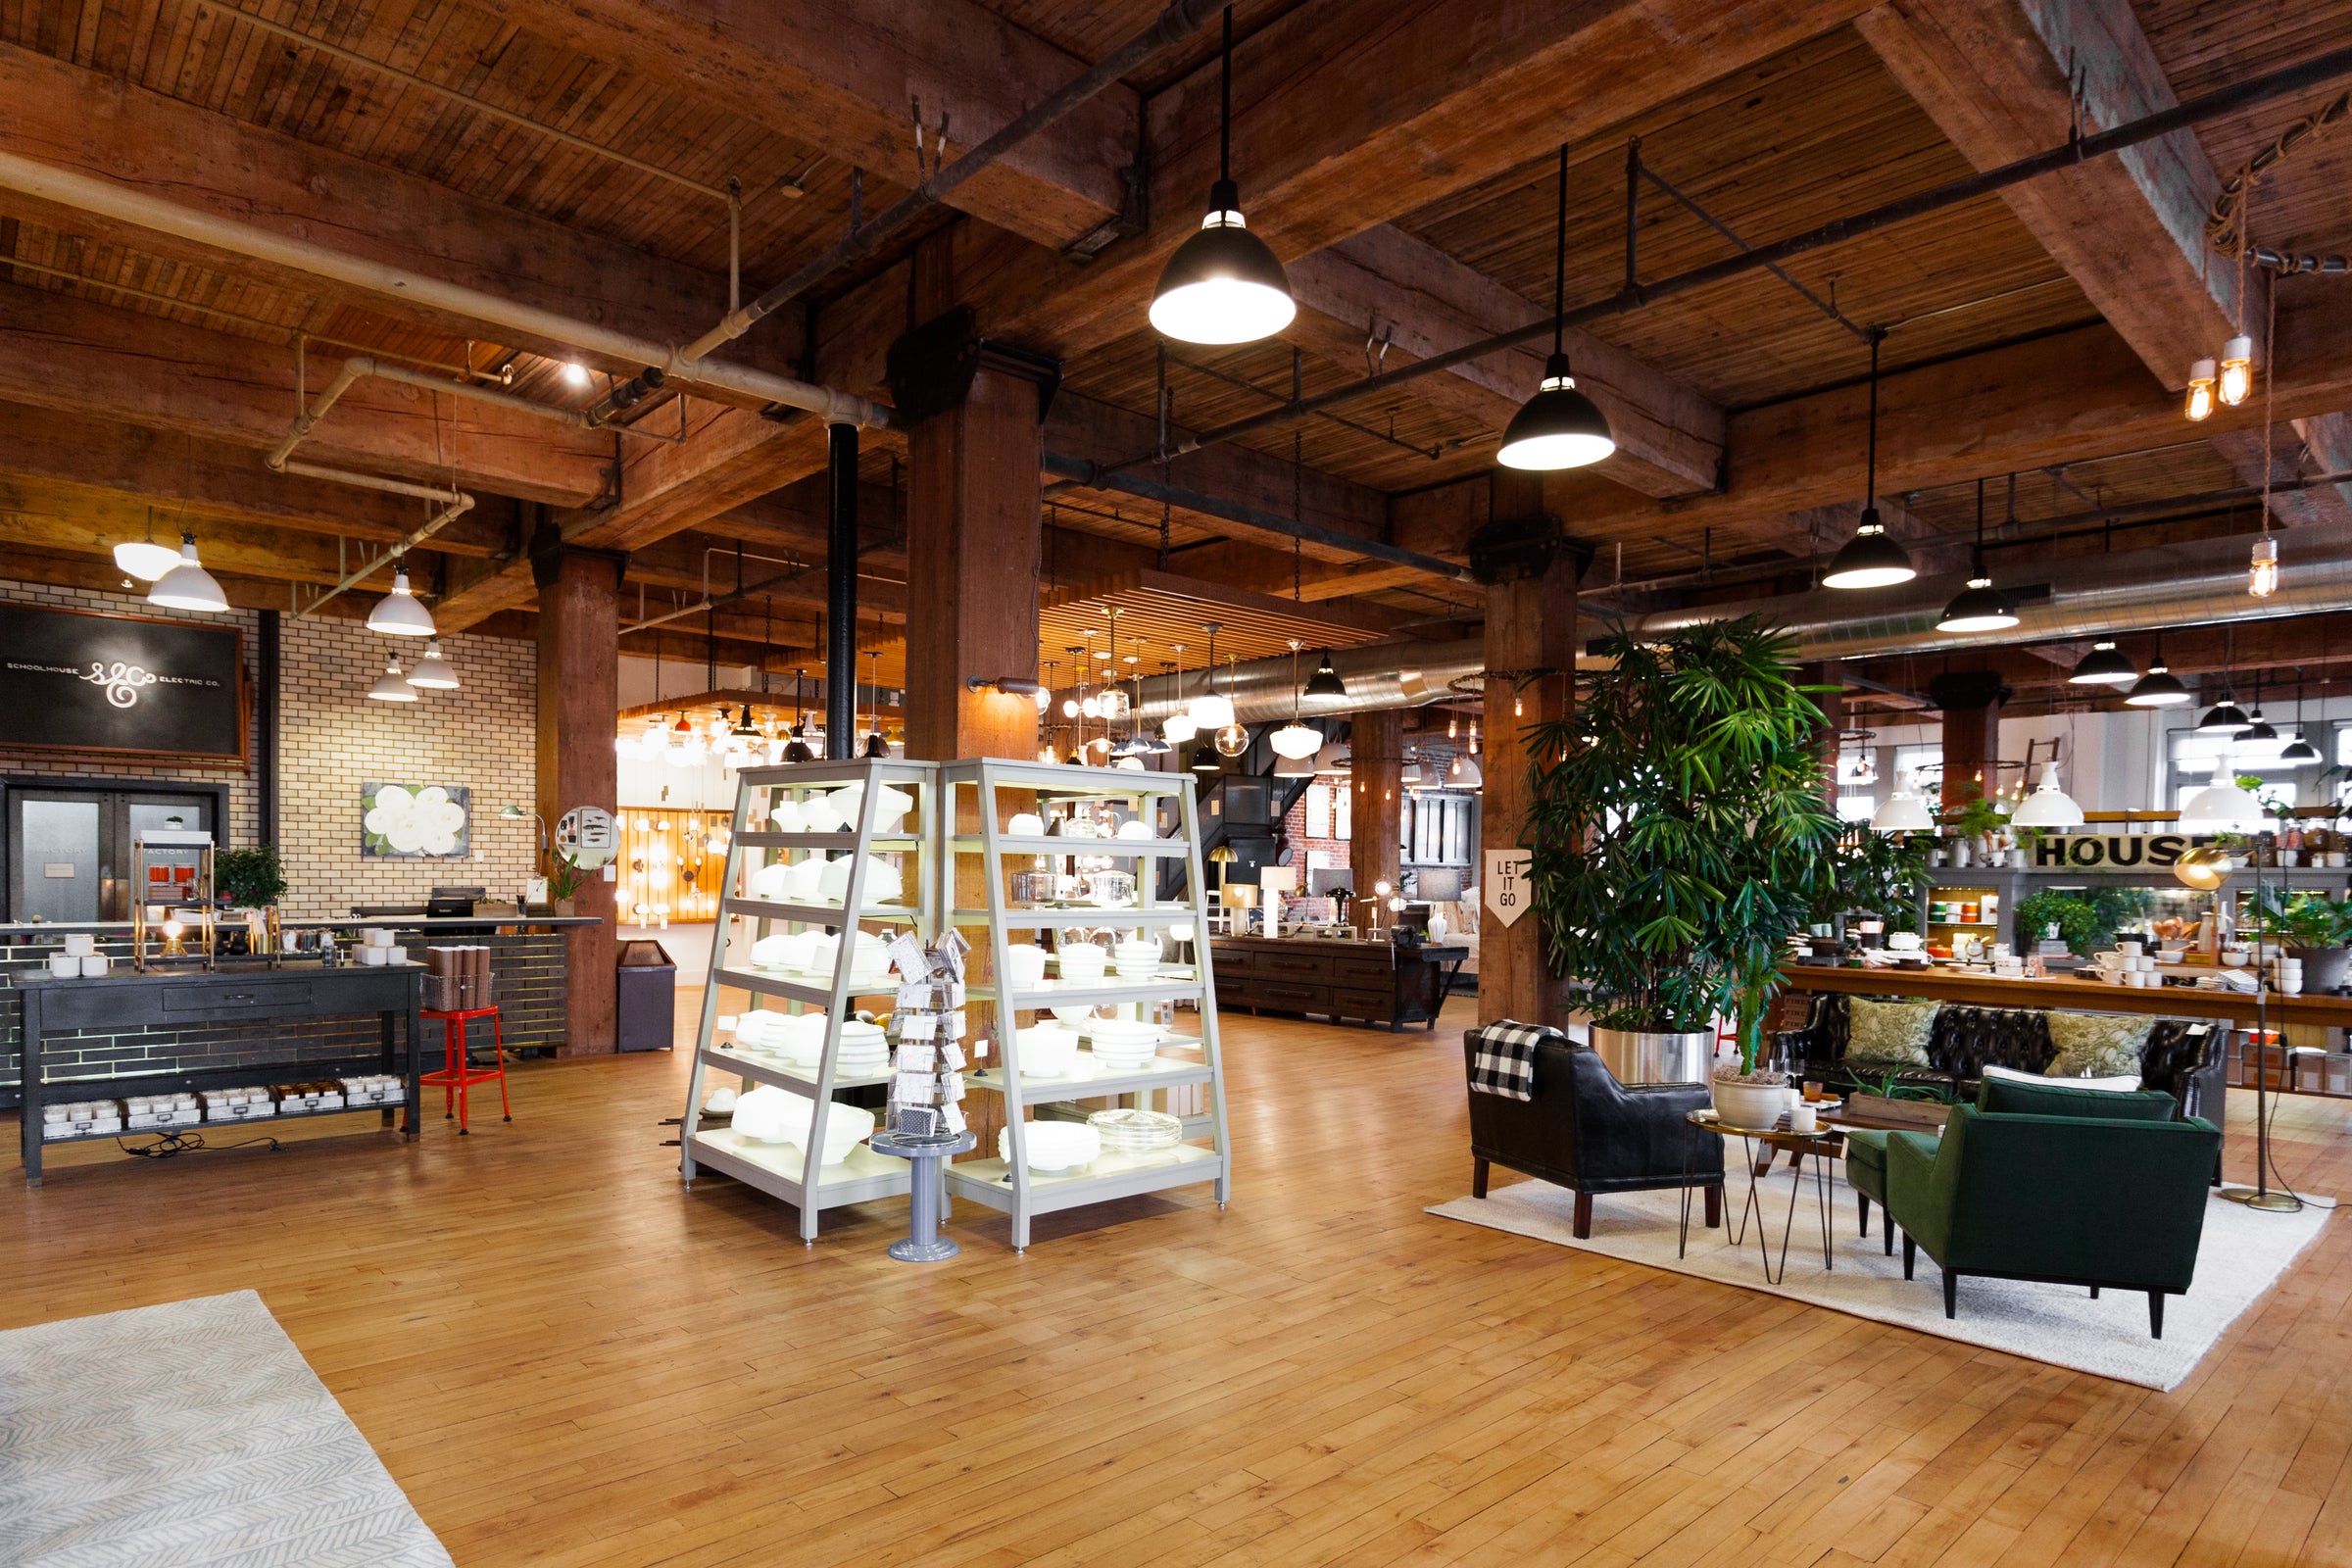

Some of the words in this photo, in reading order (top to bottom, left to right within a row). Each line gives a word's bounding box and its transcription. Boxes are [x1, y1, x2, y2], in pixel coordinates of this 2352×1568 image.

[7, 662, 79, 674] SCHOOLHOUSE
[159, 676, 203, 685] ELECTRIC
[1497, 860, 1521, 875] LET
[1503, 876, 1514, 891] IT
[1500, 893, 1516, 906] GO
